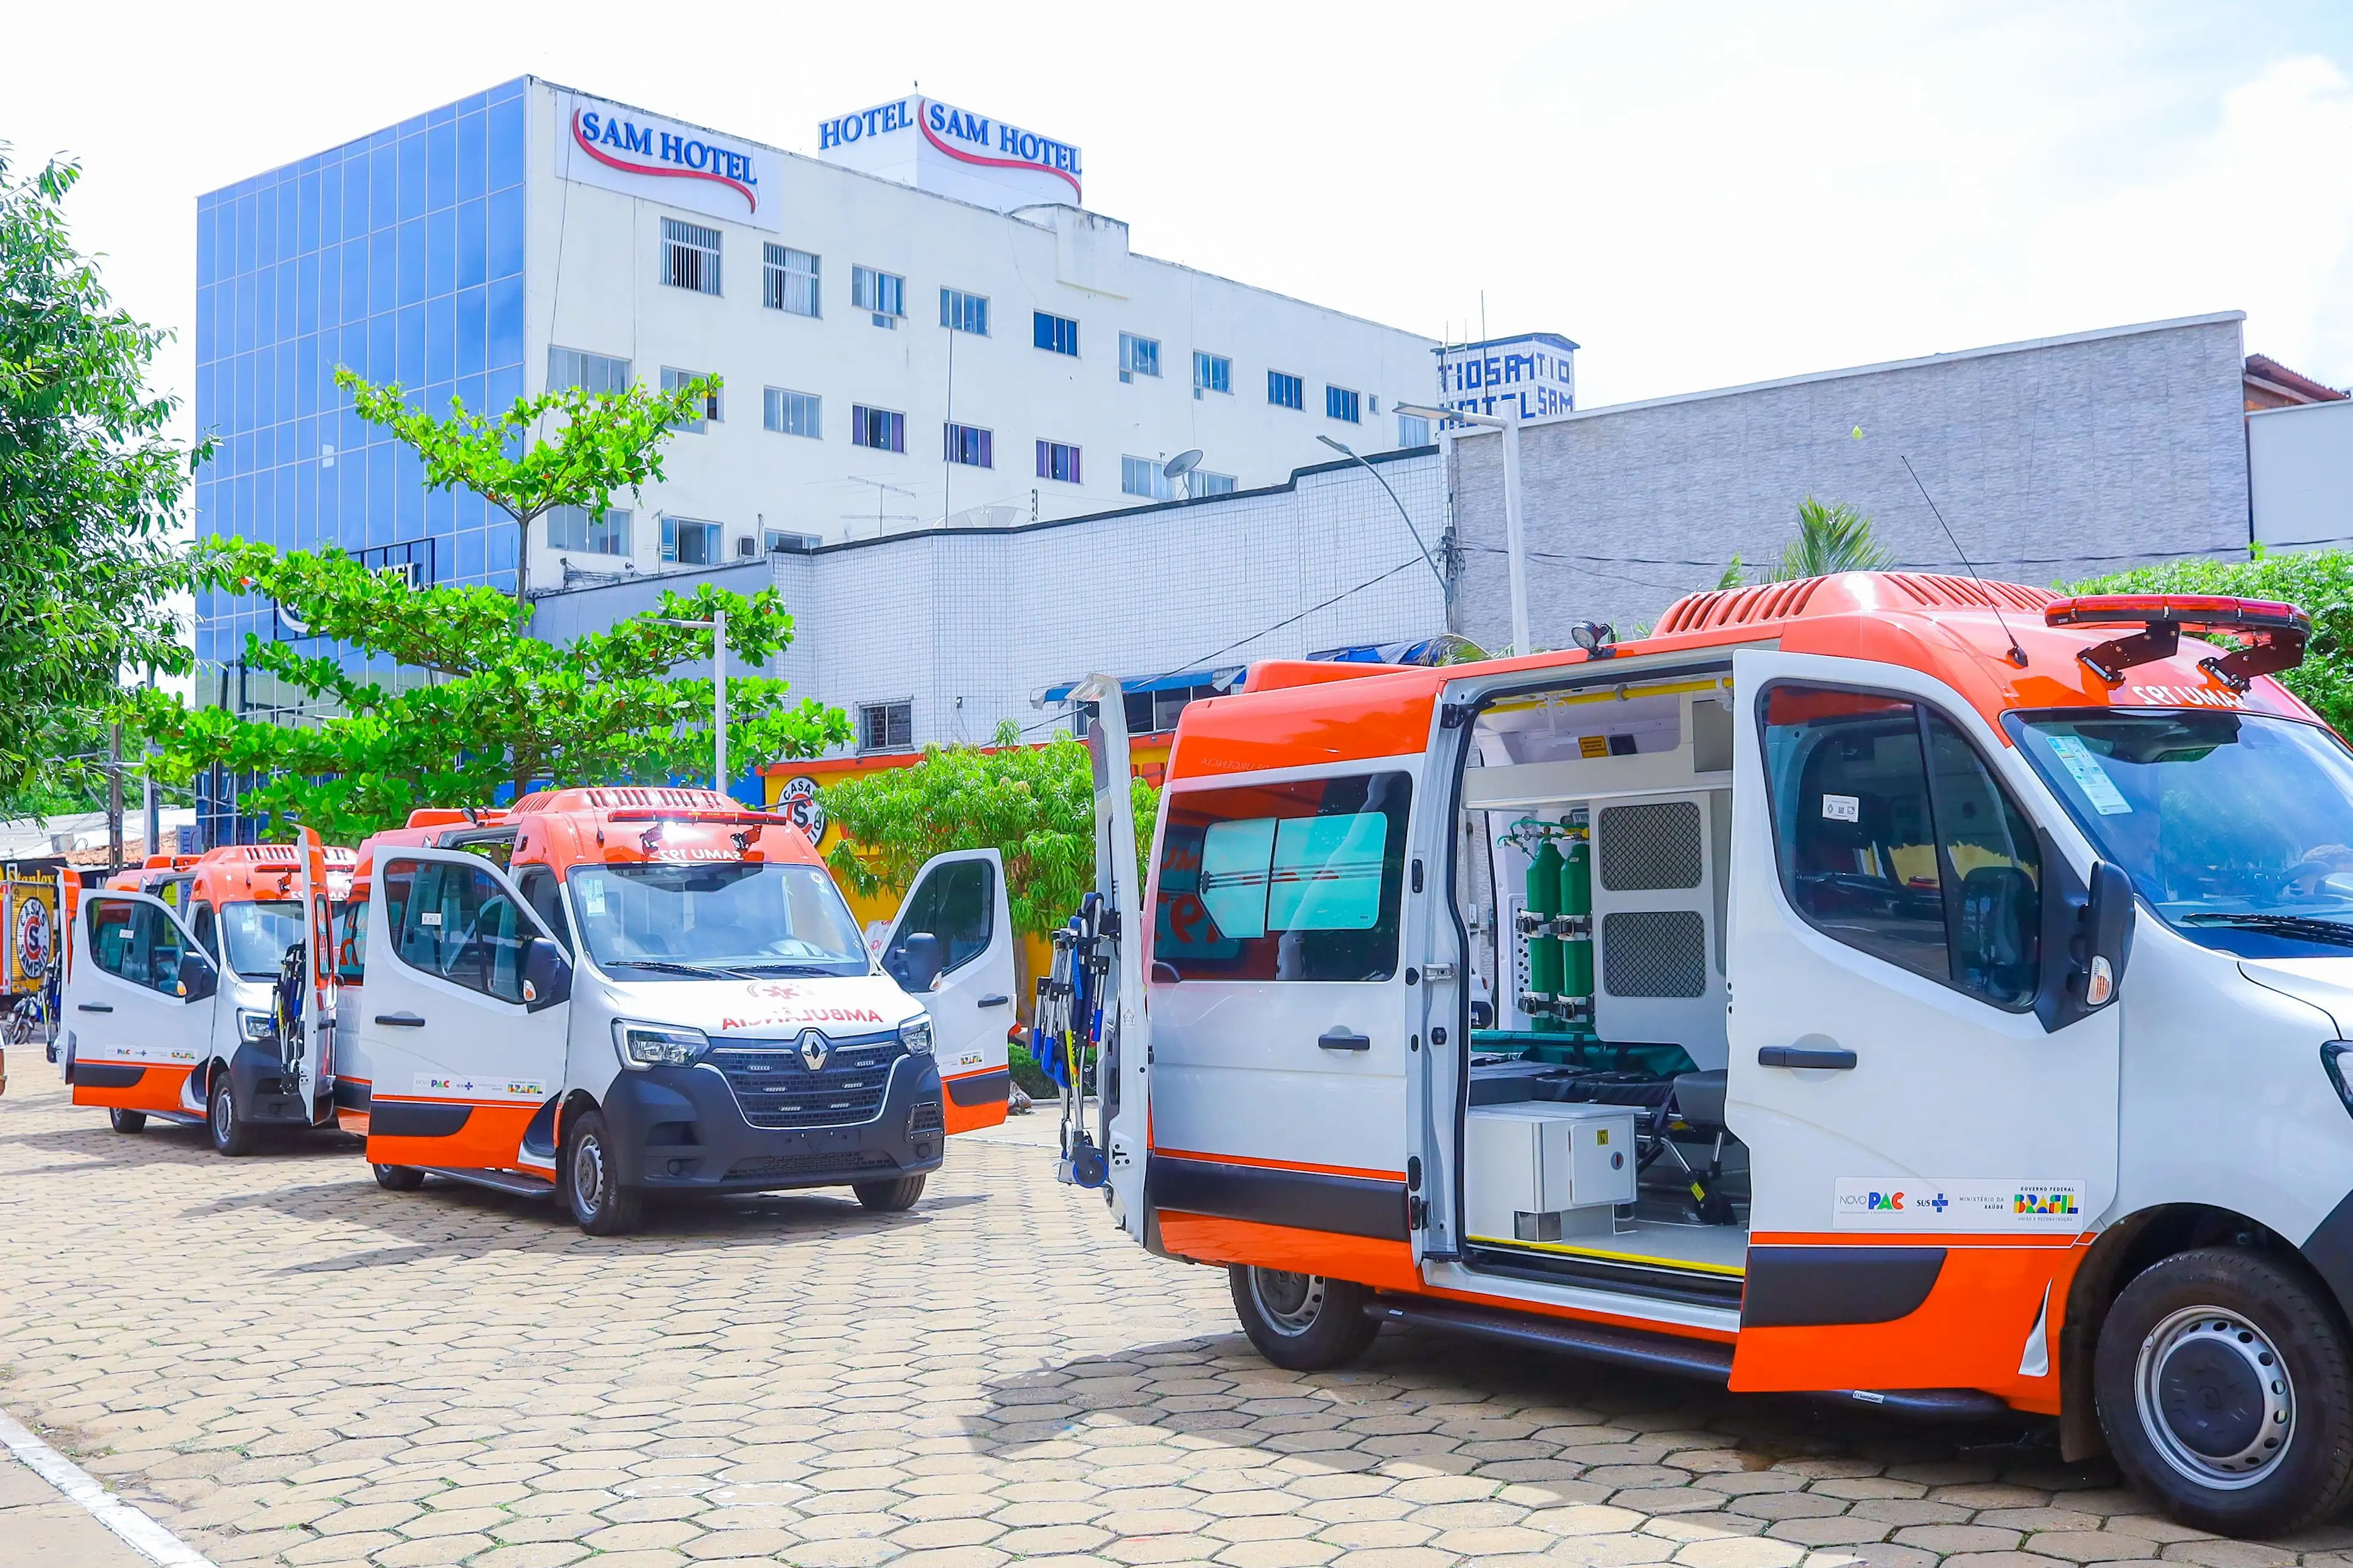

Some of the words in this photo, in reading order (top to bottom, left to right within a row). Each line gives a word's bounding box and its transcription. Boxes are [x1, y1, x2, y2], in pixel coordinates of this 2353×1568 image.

[820, 100, 913, 150] HOTEL
[930, 104, 989, 144] SAM
[1000, 125, 1082, 175] HOTEL
[581, 112, 652, 154] SAM
[660, 133, 757, 186] HOTEL
[1486, 351, 1534, 386] SAM
[1537, 353, 1570, 384] TIO
[1439, 392, 1536, 431] HOTL
[1538, 386, 1573, 415] SAM
[783, 781, 814, 800] CASA
[431, 1079, 450, 1088] PAC
[1839, 1195, 1867, 1205] NOVO
[1868, 1192, 1905, 1210] PAC
[2013, 1194, 2079, 1214] BRASIL
